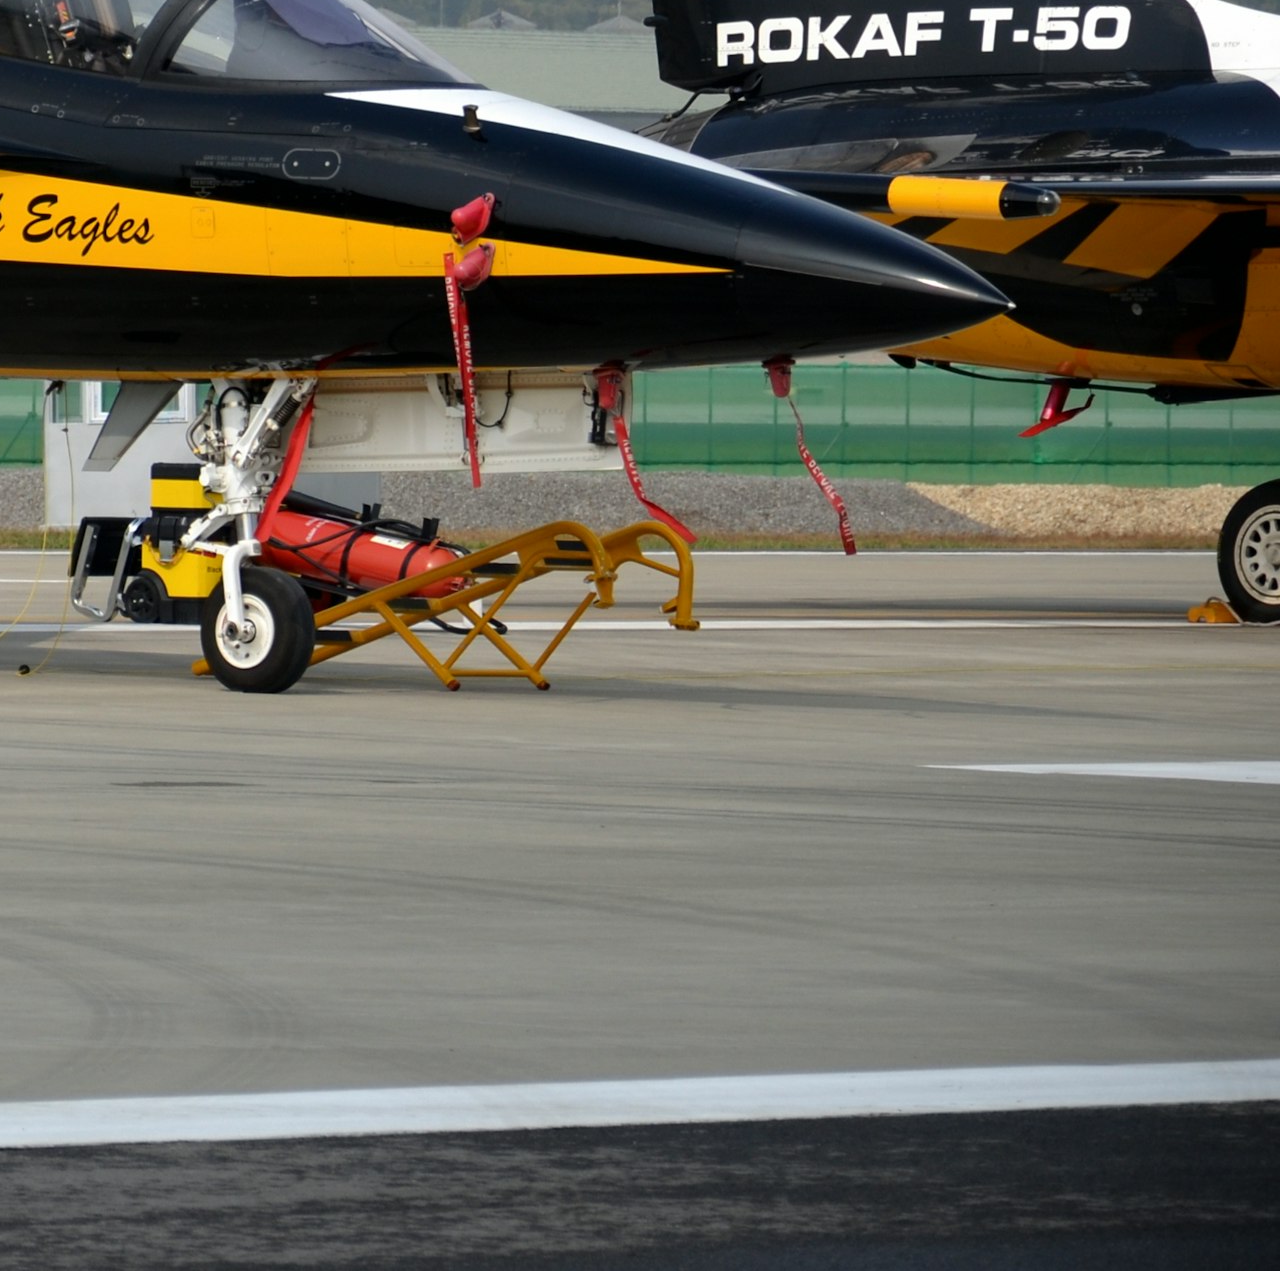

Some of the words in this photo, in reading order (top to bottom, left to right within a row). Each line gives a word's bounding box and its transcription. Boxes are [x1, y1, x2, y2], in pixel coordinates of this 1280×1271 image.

[716, 10, 945, 68] ROKAF
[969, 5, 1132, 52] T-50
[22, 193, 155, 258] Eagles
